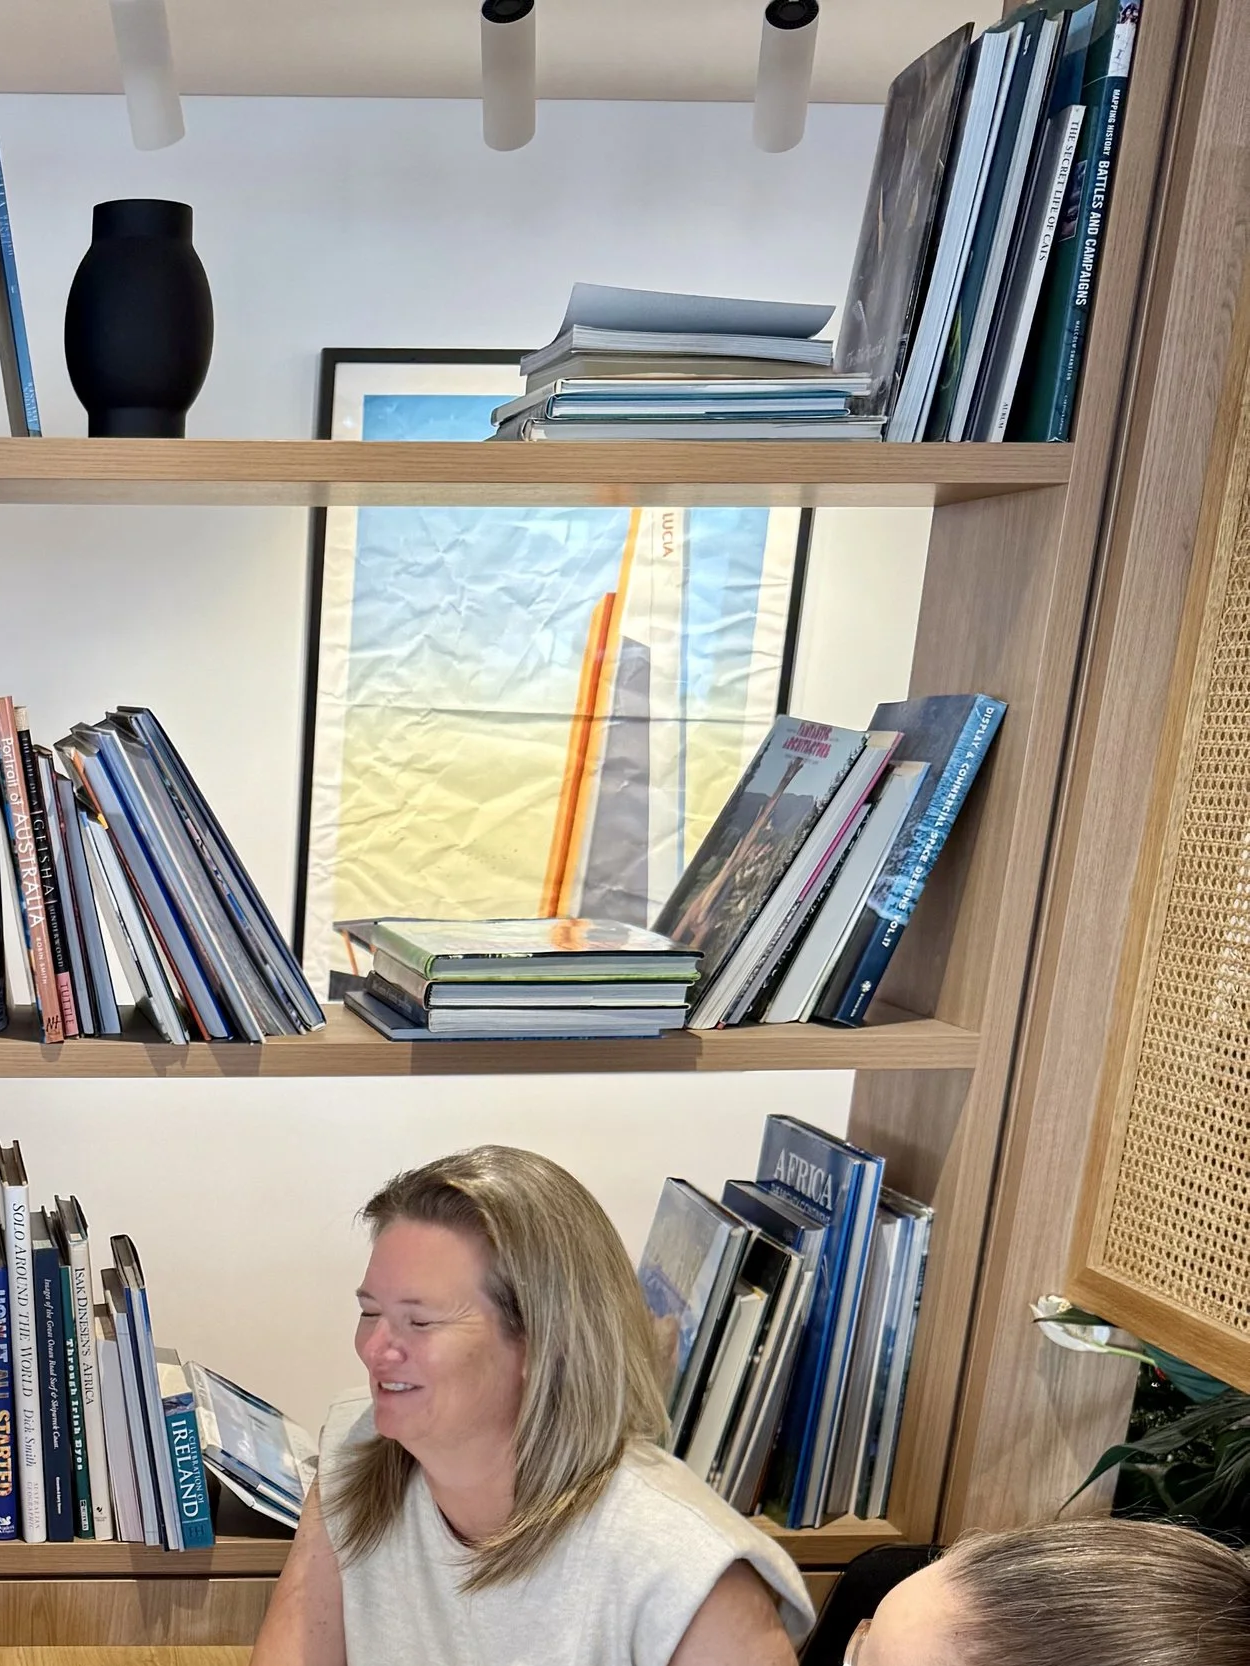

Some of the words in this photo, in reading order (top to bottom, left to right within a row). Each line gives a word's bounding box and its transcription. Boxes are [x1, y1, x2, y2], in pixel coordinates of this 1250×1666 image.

[1107, 88, 1120, 122] MAPPING
[1066, 119, 1080, 142] THE
[1101, 124, 1114, 155] HISTORY
[1055, 144, 1074, 188] SECRET
[1048, 188, 1063, 215] LIFE
[1090, 159, 1110, 210] BATTLES
[1045, 216, 1056, 231] OF
[1085, 211, 1101, 236] AND
[1037, 232, 1053, 262] CATS
[1074, 237, 1097, 306] CAMPAIGNS
[662, 513, 674, 557] LUCIA
[972, 707, 994, 748] DISPLAY
[0, 736, 20, 787] Portrait
[963, 750, 974, 759] &
[8, 792, 23, 806] of
[936, 762, 969, 828] COMMERCIAL
[34, 819, 54, 896] GEISHA
[920, 831, 939, 863] SPACE
[13, 813, 45, 928] AUSTRALIA
[898, 865, 923, 910] DESIGNS
[46, 904, 64, 968] UNDERWOOD
[881, 913, 902, 948] VOL.17
[34, 937, 44, 960] ROBIN
[38, 962, 48, 984] SMITH
[58, 982, 74, 1025] TUTTLE
[773, 1150, 833, 1211] AFRICA
[11, 1203, 26, 1240] SOLO
[13, 1244, 30, 1305] AROUND
[41, 1278, 52, 1300] Images
[73, 1267, 87, 1294] ISAK
[17, 1312, 31, 1341] THE
[44, 1309, 53, 1318] the
[75, 1296, 93, 1356] DINESEN'S
[46, 1339, 55, 1358] Ocean
[19, 1347, 34, 1397] WORLD
[48, 1377, 57, 1390] Surf
[63, 1339, 78, 1395] Through
[81, 1362, 96, 1404] AFRICA
[22, 1409, 35, 1433] Dick
[70, 1400, 82, 1434] Irish
[23, 1436, 37, 1467] Smith
[73, 1439, 85, 1470] Eyes
[170, 1419, 198, 1518] IRELAND
